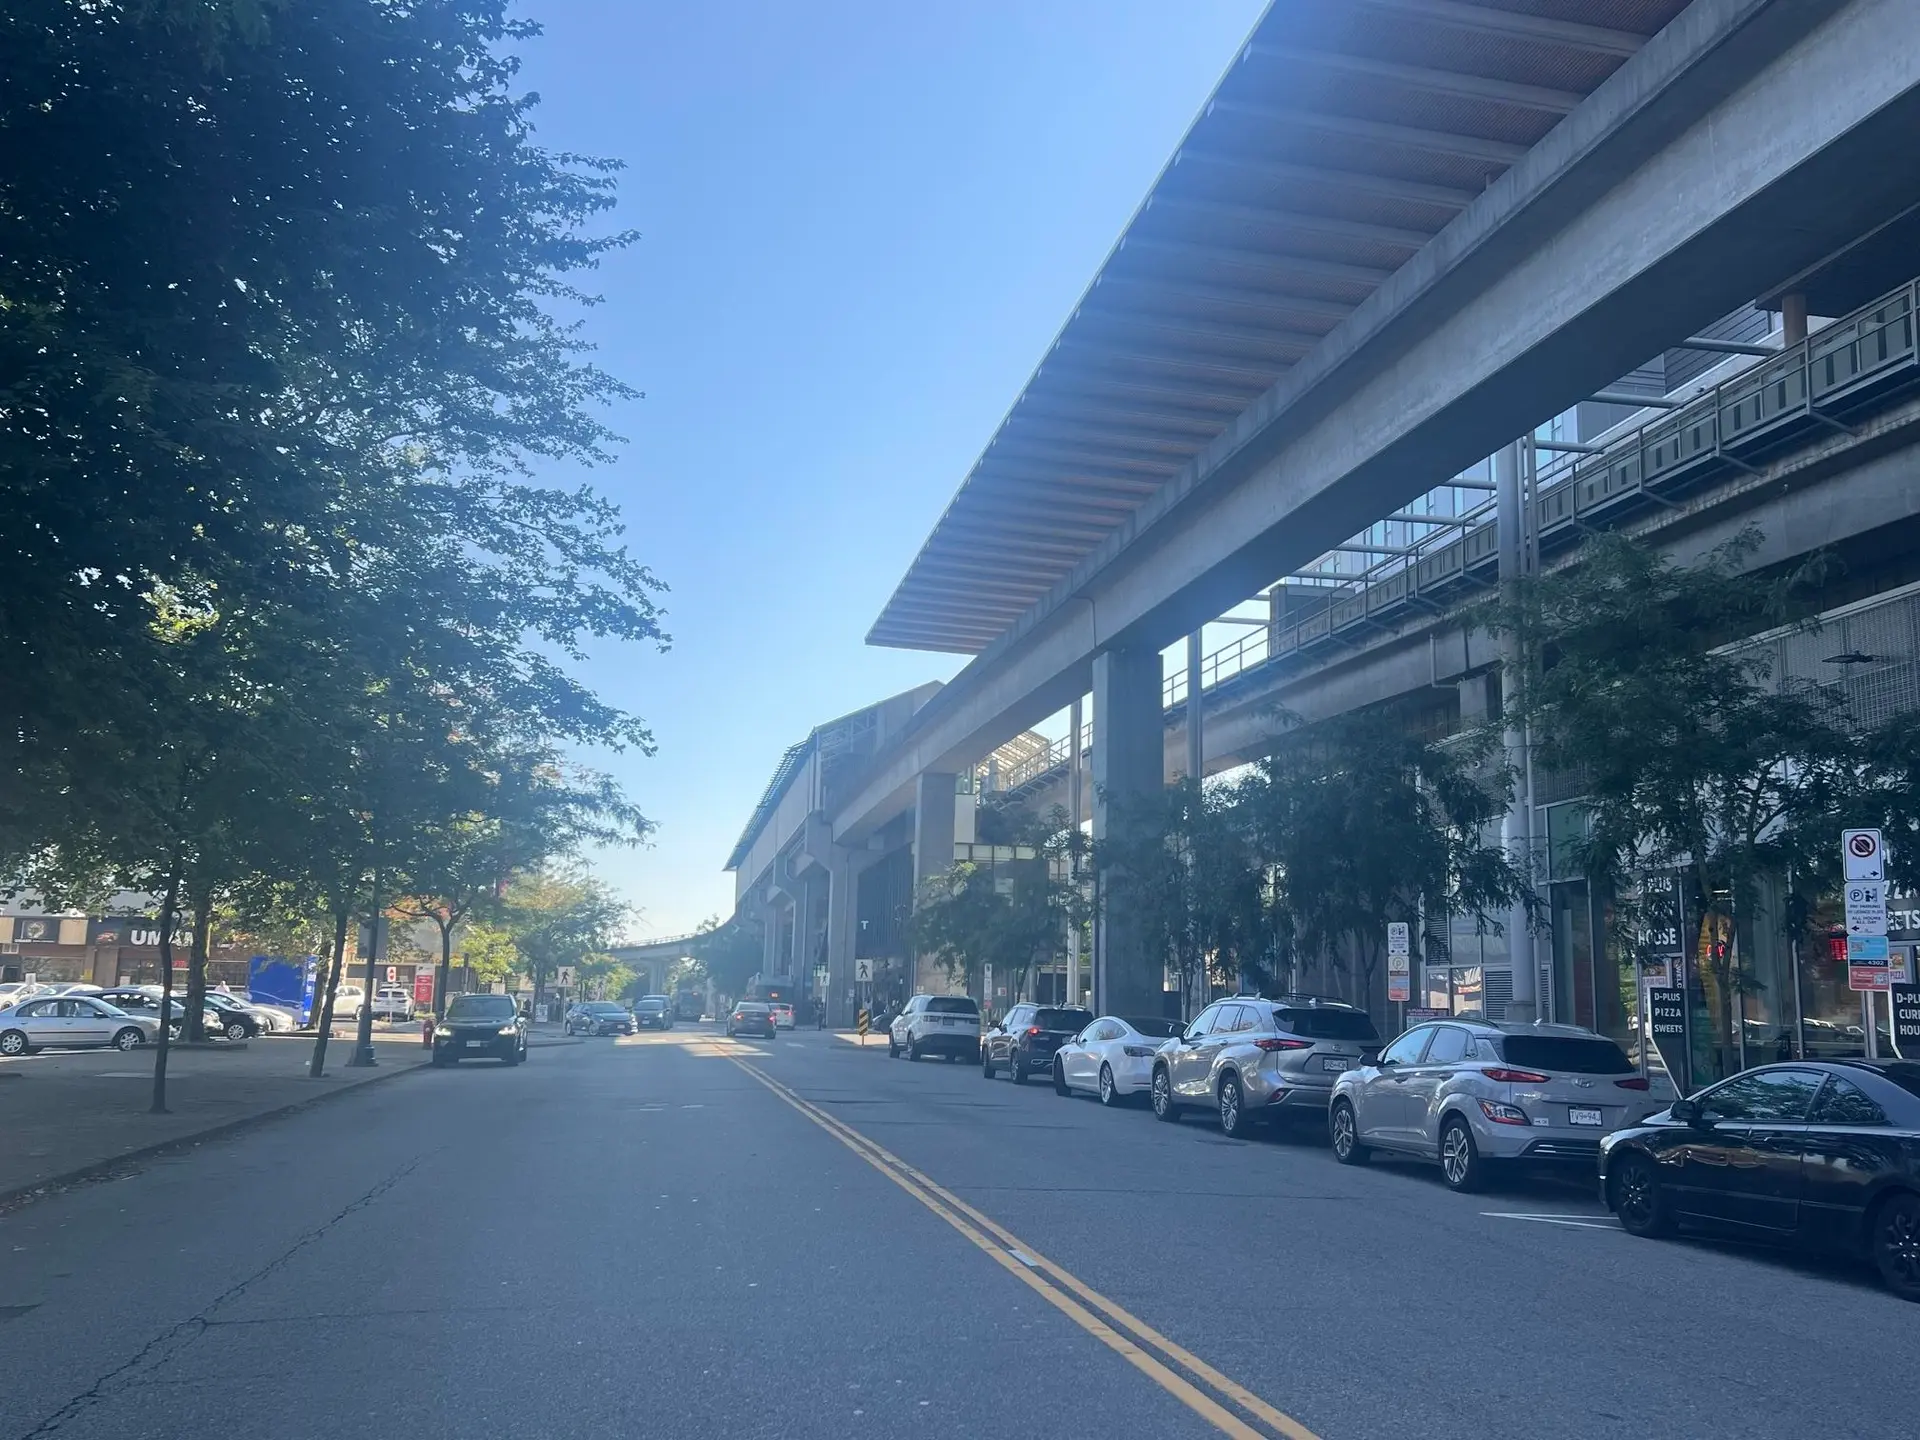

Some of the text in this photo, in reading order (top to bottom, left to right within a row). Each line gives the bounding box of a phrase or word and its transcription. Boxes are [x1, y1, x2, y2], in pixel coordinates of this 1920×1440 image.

[1638, 927, 1677, 946] HOUSE
[1654, 992, 1681, 1001] D-PLUS
[1654, 1007, 1682, 1017] PIZZA
[1654, 1024, 1684, 1033] SWEETS
